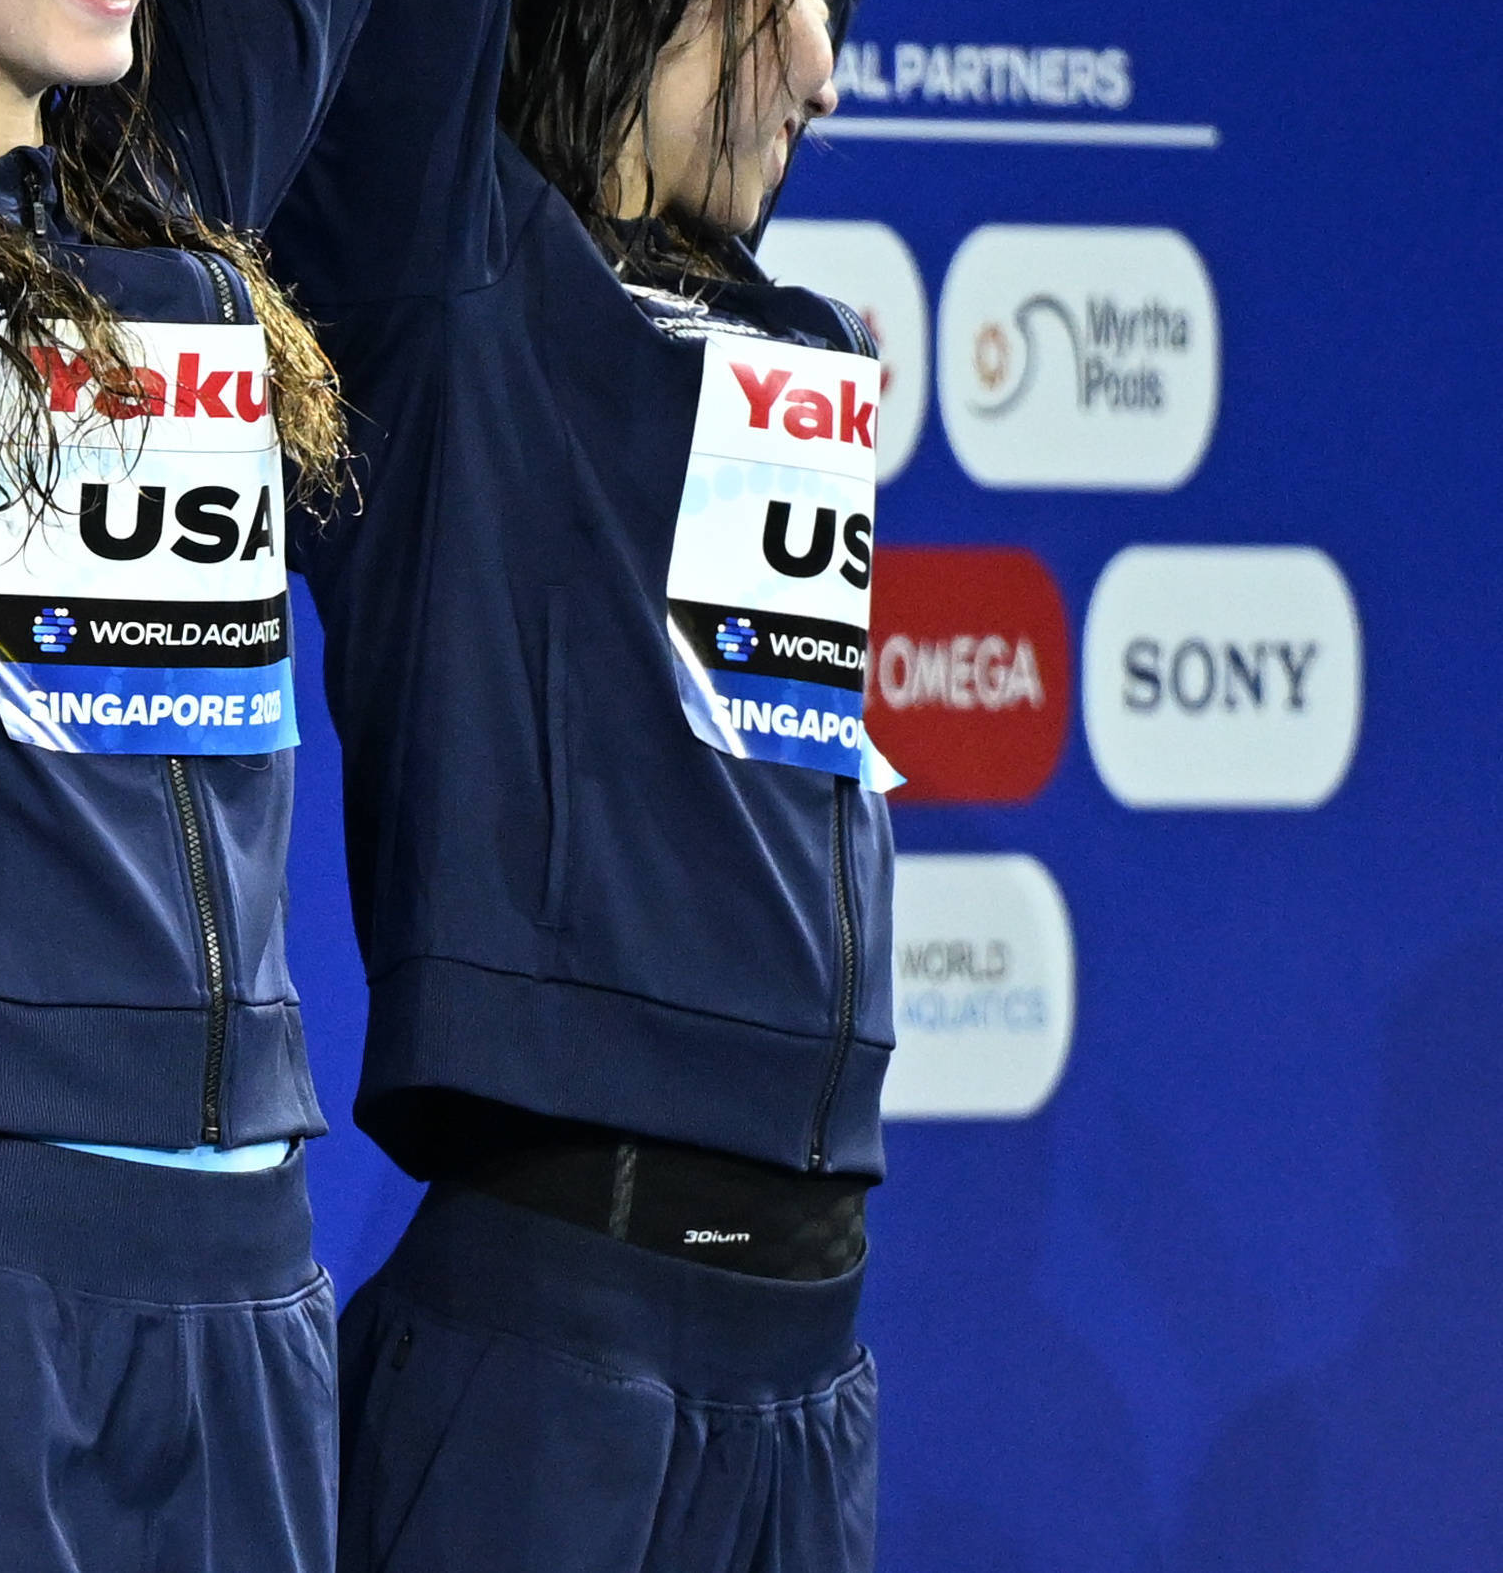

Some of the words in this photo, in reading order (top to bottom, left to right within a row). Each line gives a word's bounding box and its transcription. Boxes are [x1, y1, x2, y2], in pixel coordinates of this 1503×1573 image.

[894, 41, 1132, 110] PARTNERS
[729, 362, 877, 449] Yak
[1083, 358, 1164, 411] Pools
[80, 483, 275, 563] USA
[879, 634, 1044, 711] OMEGA
[1122, 637, 1321, 714] SONY
[29, 691, 245, 726] SINGAPORE
[712, 695, 864, 749] SINGAPO
[897, 941, 1008, 983] WORLD
